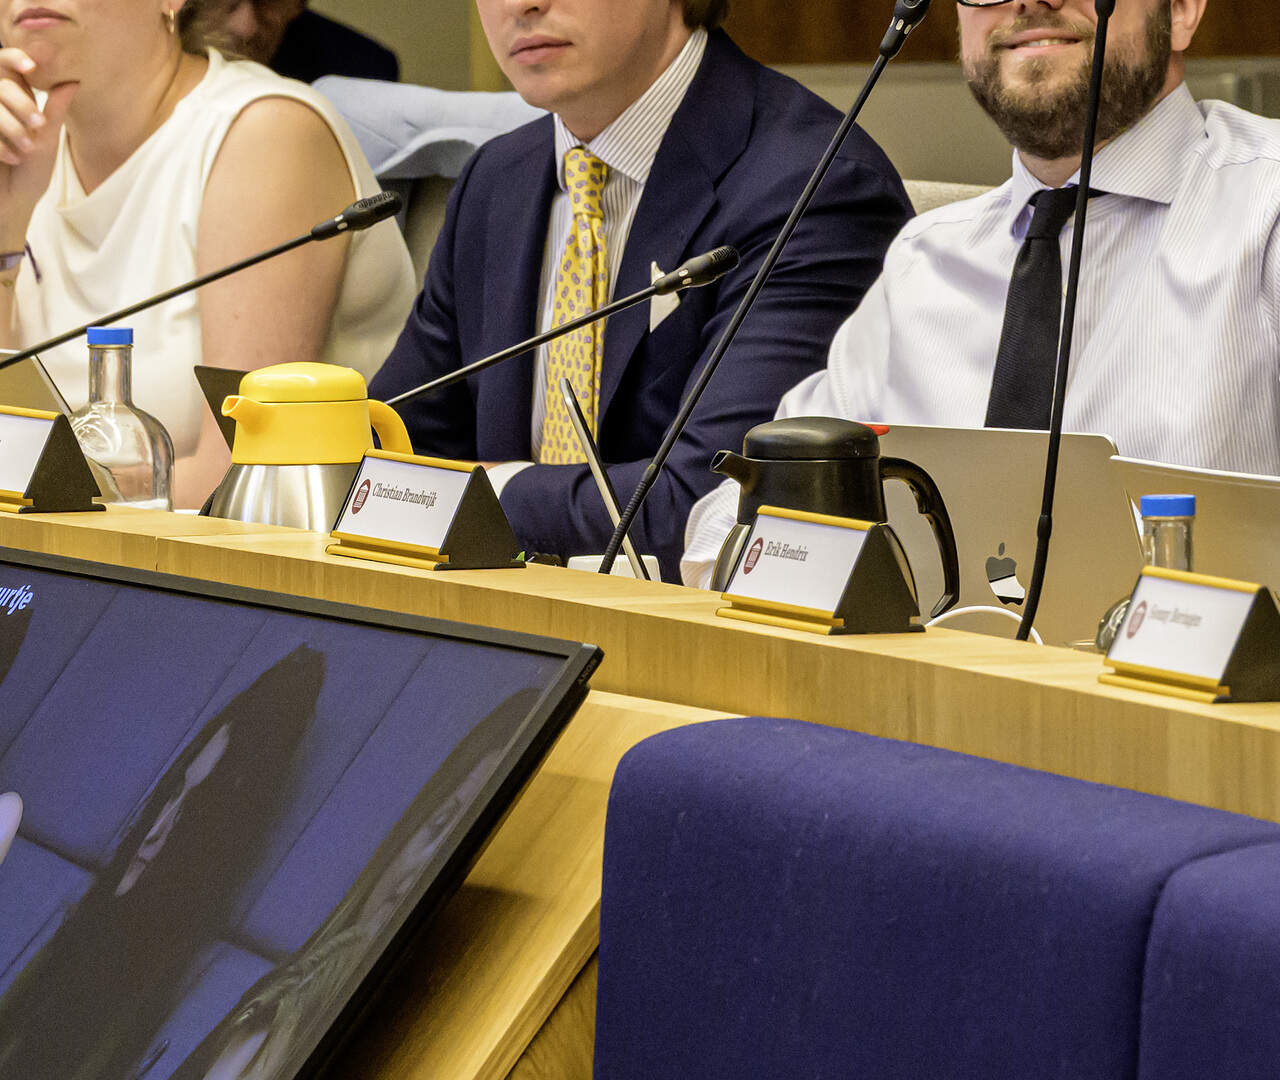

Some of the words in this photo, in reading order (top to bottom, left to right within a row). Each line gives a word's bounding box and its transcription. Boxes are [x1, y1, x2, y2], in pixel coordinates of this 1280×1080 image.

[372, 482, 403, 501] Christian
[401, 487, 437, 508] Brandwijk
[764, 540, 782, 557] Erik
